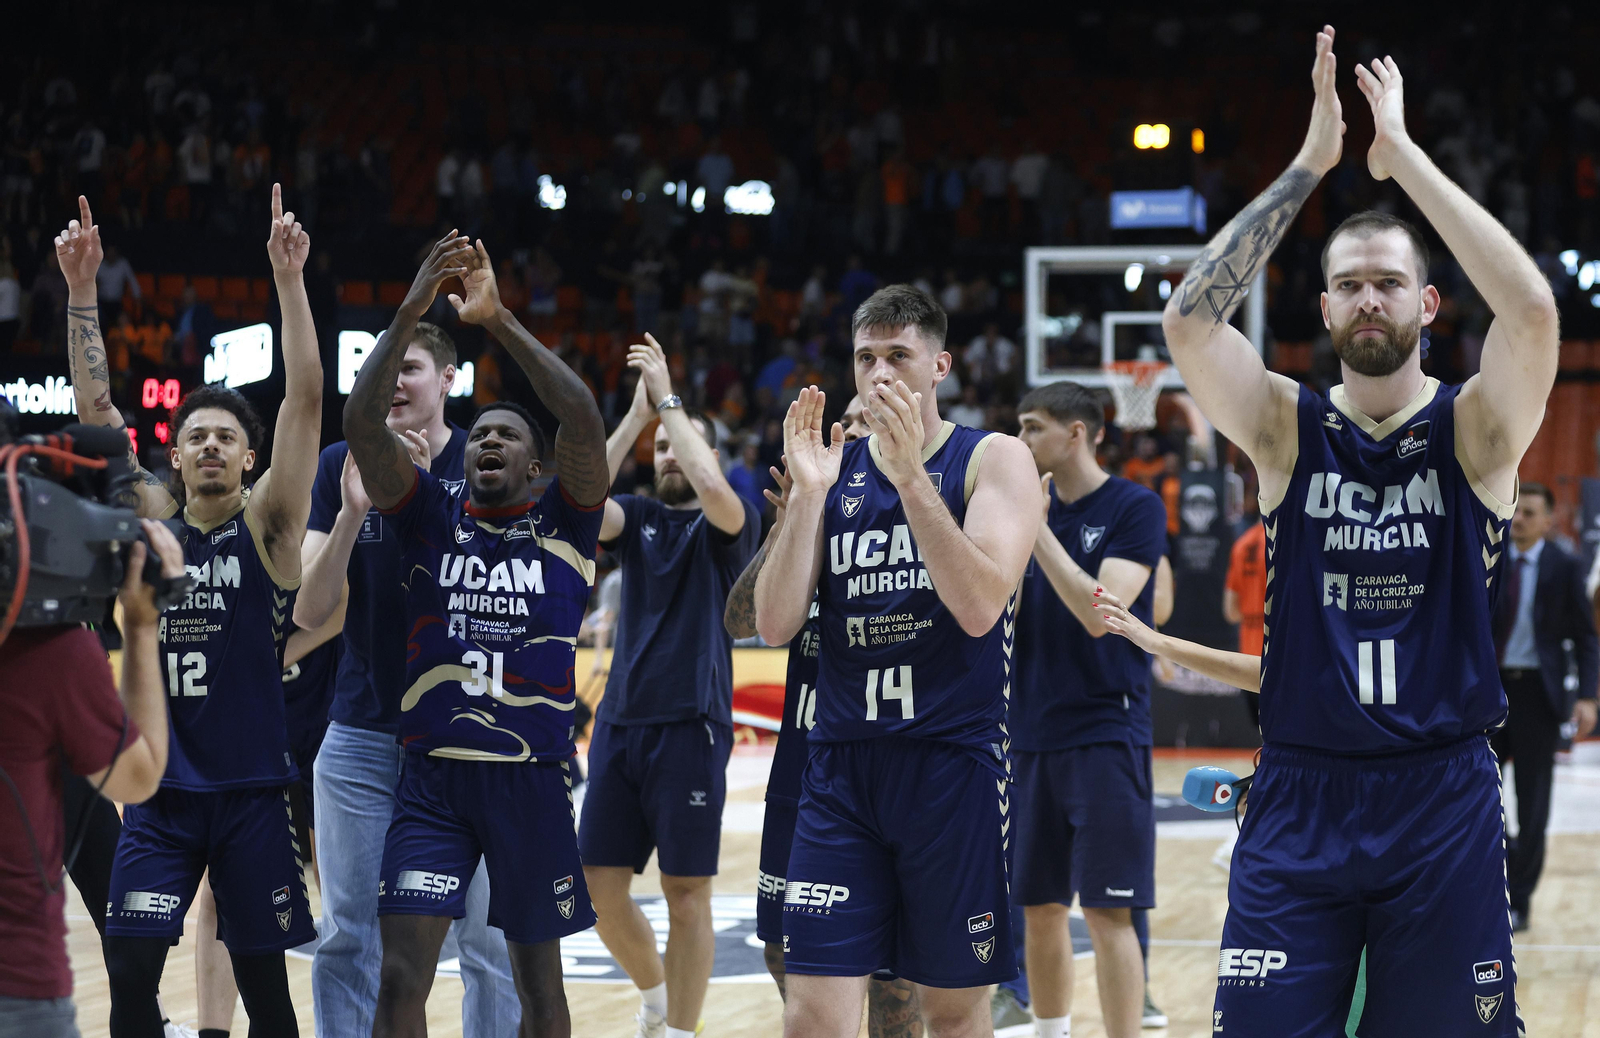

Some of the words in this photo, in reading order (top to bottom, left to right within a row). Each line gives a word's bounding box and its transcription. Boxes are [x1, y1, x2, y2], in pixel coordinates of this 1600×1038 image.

[1401, 438, 1427, 453] endes
[1304, 468, 1446, 527] UCAM
[1323, 522, 1430, 551] MURCIA
[830, 524, 925, 576] UCA
[438, 553, 546, 594] UCAM
[1355, 574, 1408, 586] CARAVACA
[847, 568, 934, 600] MURCIA
[1355, 588, 1367, 597] DE
[1369, 588, 1380, 597] LA
[1382, 586, 1407, 597] CRUZ
[1408, 584, 1425, 595] 202
[447, 593, 529, 616] MURCIA
[1354, 598, 1375, 610] AÑO
[1376, 598, 1413, 612] JUBILAR
[470, 618, 510, 628] CARAVACA
[869, 613, 914, 624] CARAVACA
[870, 626, 879, 635] DE
[880, 625, 891, 634] LA
[891, 623, 913, 632] CRUZ
[914, 619, 933, 630] 2024
[171, 634, 184, 642] AÑO
[180, 626, 188, 634] LA
[205, 624, 222, 632] 2024
[870, 634, 887, 645] AÑO
[887, 631, 917, 645] JUBILAR
[167, 651, 208, 697] 12
[461, 650, 504, 698] 31
[1358, 639, 1397, 705] 11
[865, 665, 915, 721] 14
[409, 870, 460, 895] ESP
[136, 892, 180, 914] ESP
[393, 890, 446, 901] SOLUTIONS
[790, 882, 850, 908] ESP
[120, 911, 172, 920] SOLUTIONS
[971, 920, 988, 930] acb
[1221, 948, 1288, 978] ESP
[1478, 969, 1497, 980] acb
